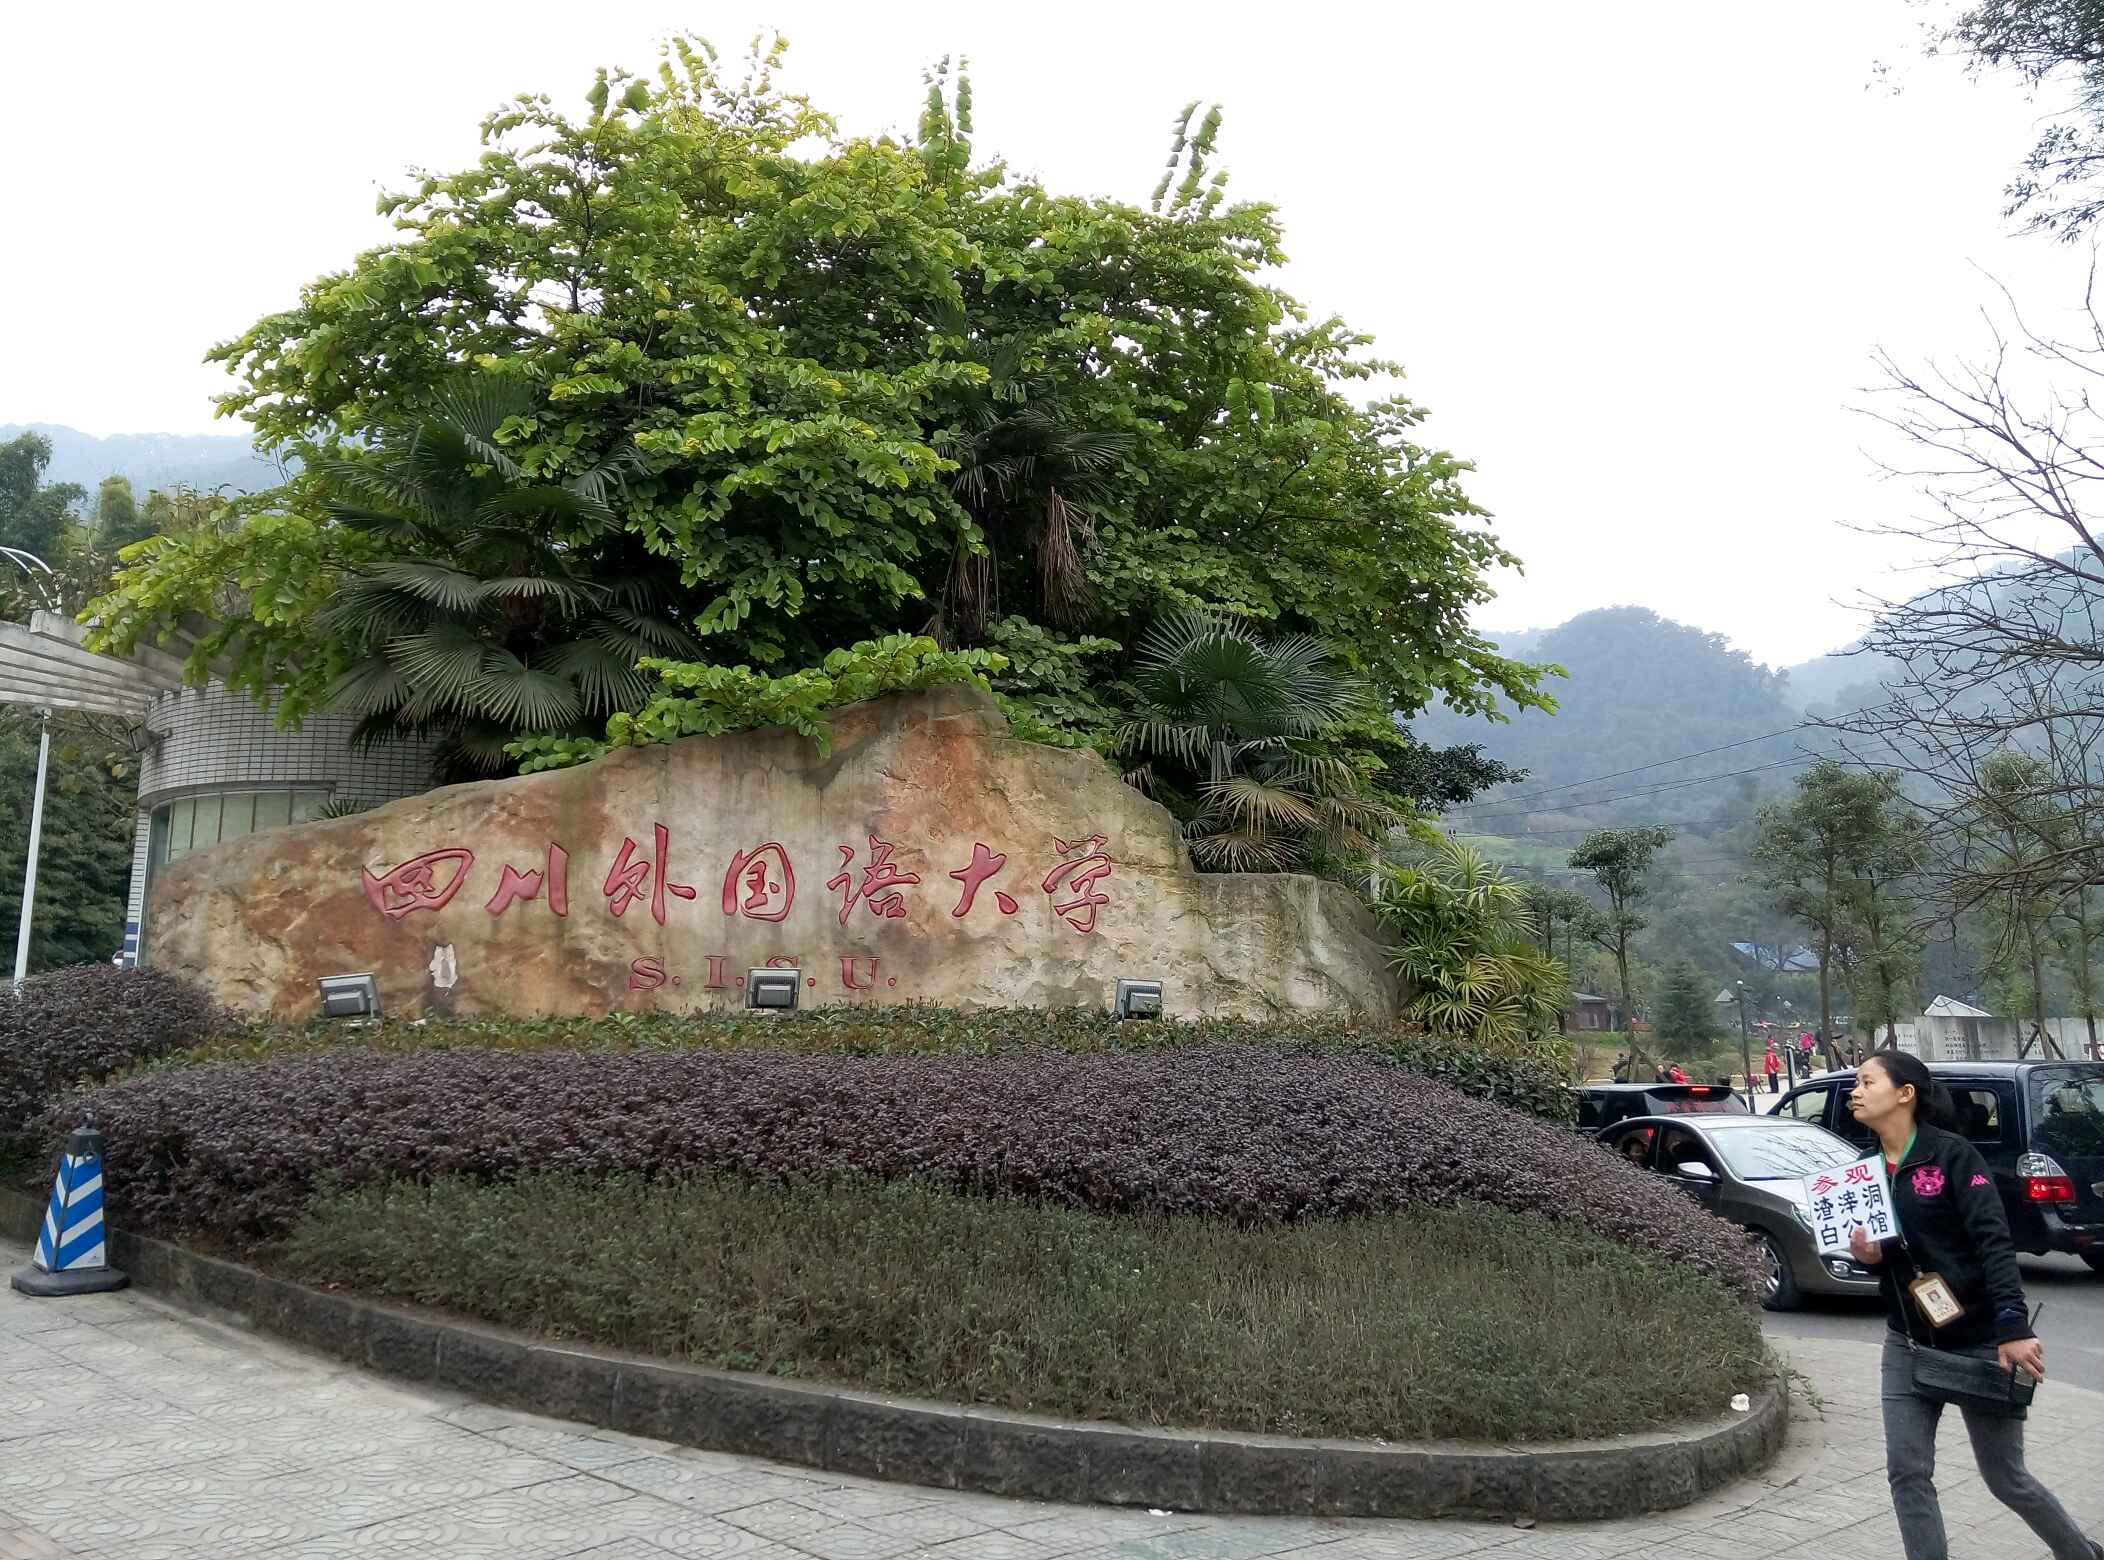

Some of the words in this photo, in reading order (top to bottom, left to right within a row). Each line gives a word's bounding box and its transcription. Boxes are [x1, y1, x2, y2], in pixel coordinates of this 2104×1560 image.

[361, 822, 1113, 933] 四川外国语大学
[1811, 1164, 1873, 1196] 参观
[1820, 1209, 1889, 1246] 白公馆
